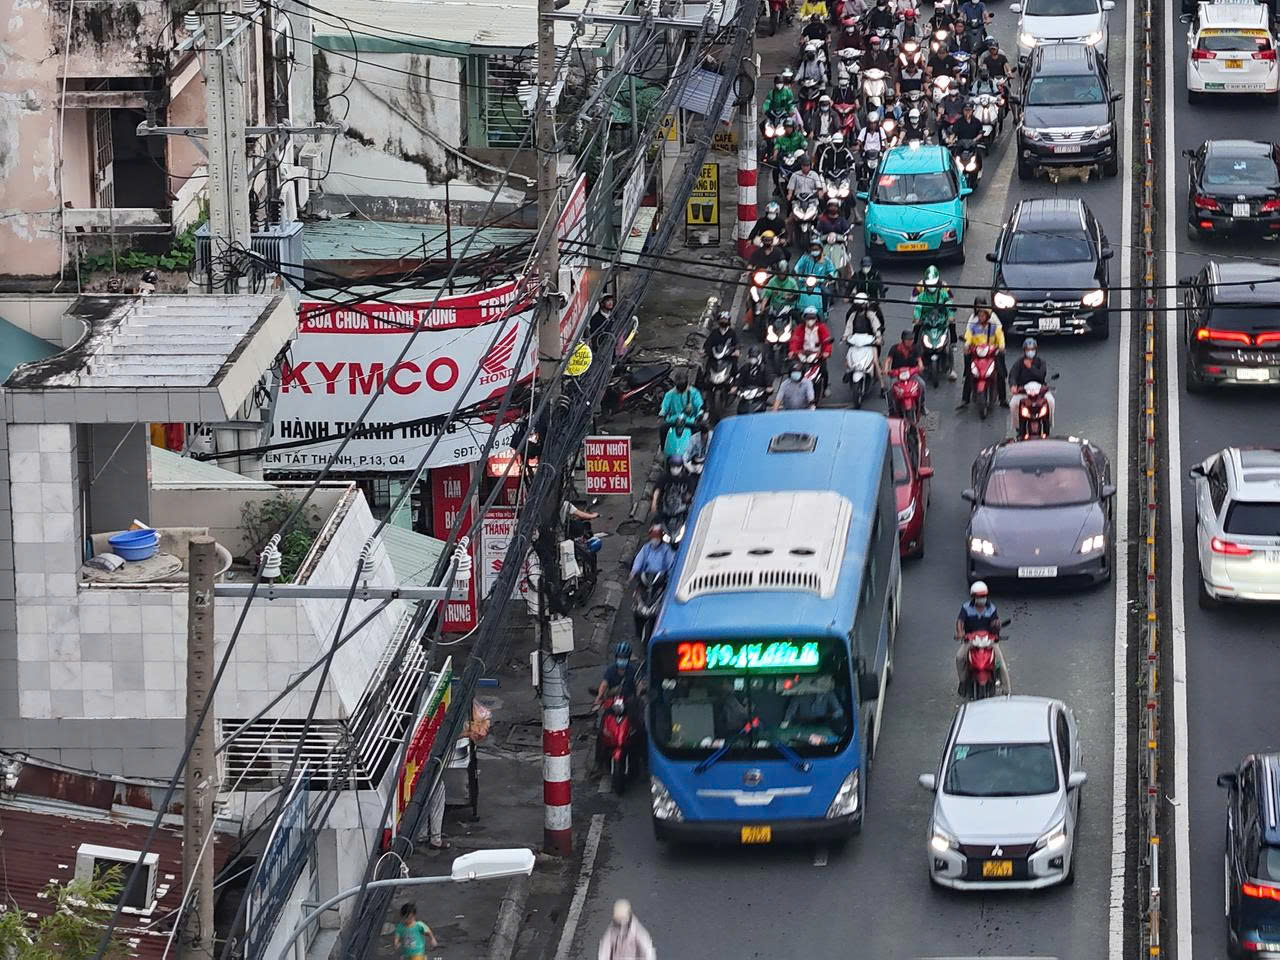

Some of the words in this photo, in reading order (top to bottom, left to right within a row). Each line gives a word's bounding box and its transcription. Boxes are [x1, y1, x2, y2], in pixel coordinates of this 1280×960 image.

[281, 356, 459, 395] KYMCO
[480, 369, 514, 386] HOND
[280, 417, 328, 440] HÀNH
[586, 444, 604, 456] THAY
[607, 441, 628, 456] NHỚT
[286, 450, 308, 464] TẤT
[389, 454, 405, 465] Q4
[586, 456, 610, 472] RỬA
[612, 460, 628, 472] XE
[587, 477, 606, 491] BỌC
[678, 642, 706, 671] 20
